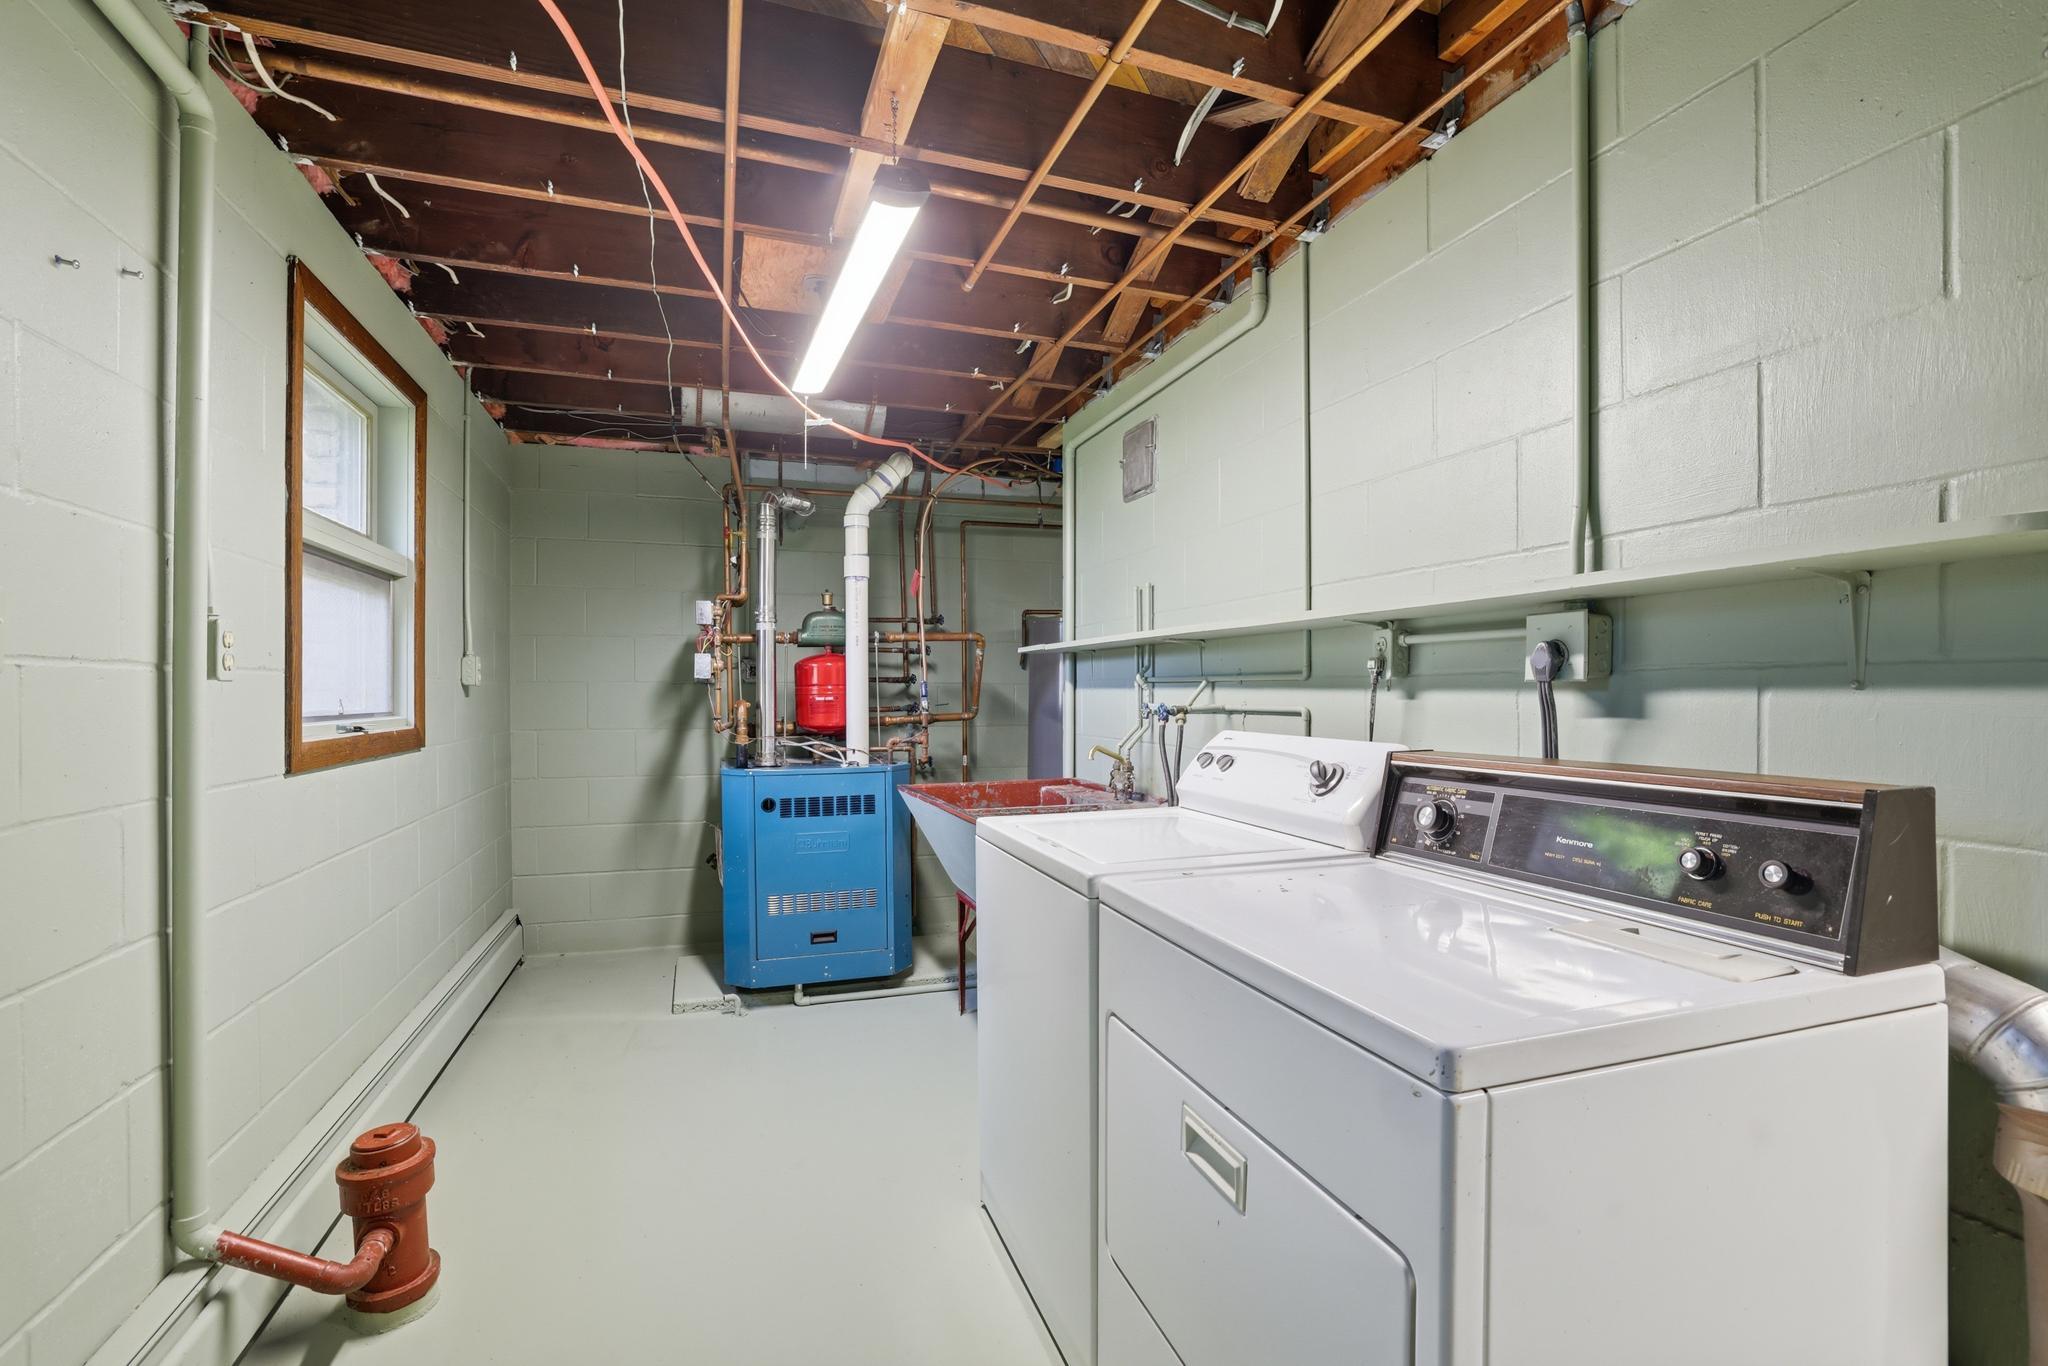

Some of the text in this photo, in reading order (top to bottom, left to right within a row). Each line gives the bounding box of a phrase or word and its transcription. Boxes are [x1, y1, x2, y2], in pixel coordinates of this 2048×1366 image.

[1556, 835, 1593, 848] Kenmore
[1678, 896, 1712, 909] FABRIC CARE
[1755, 912, 1771, 921] PUSH
[1783, 918, 1804, 928] START
